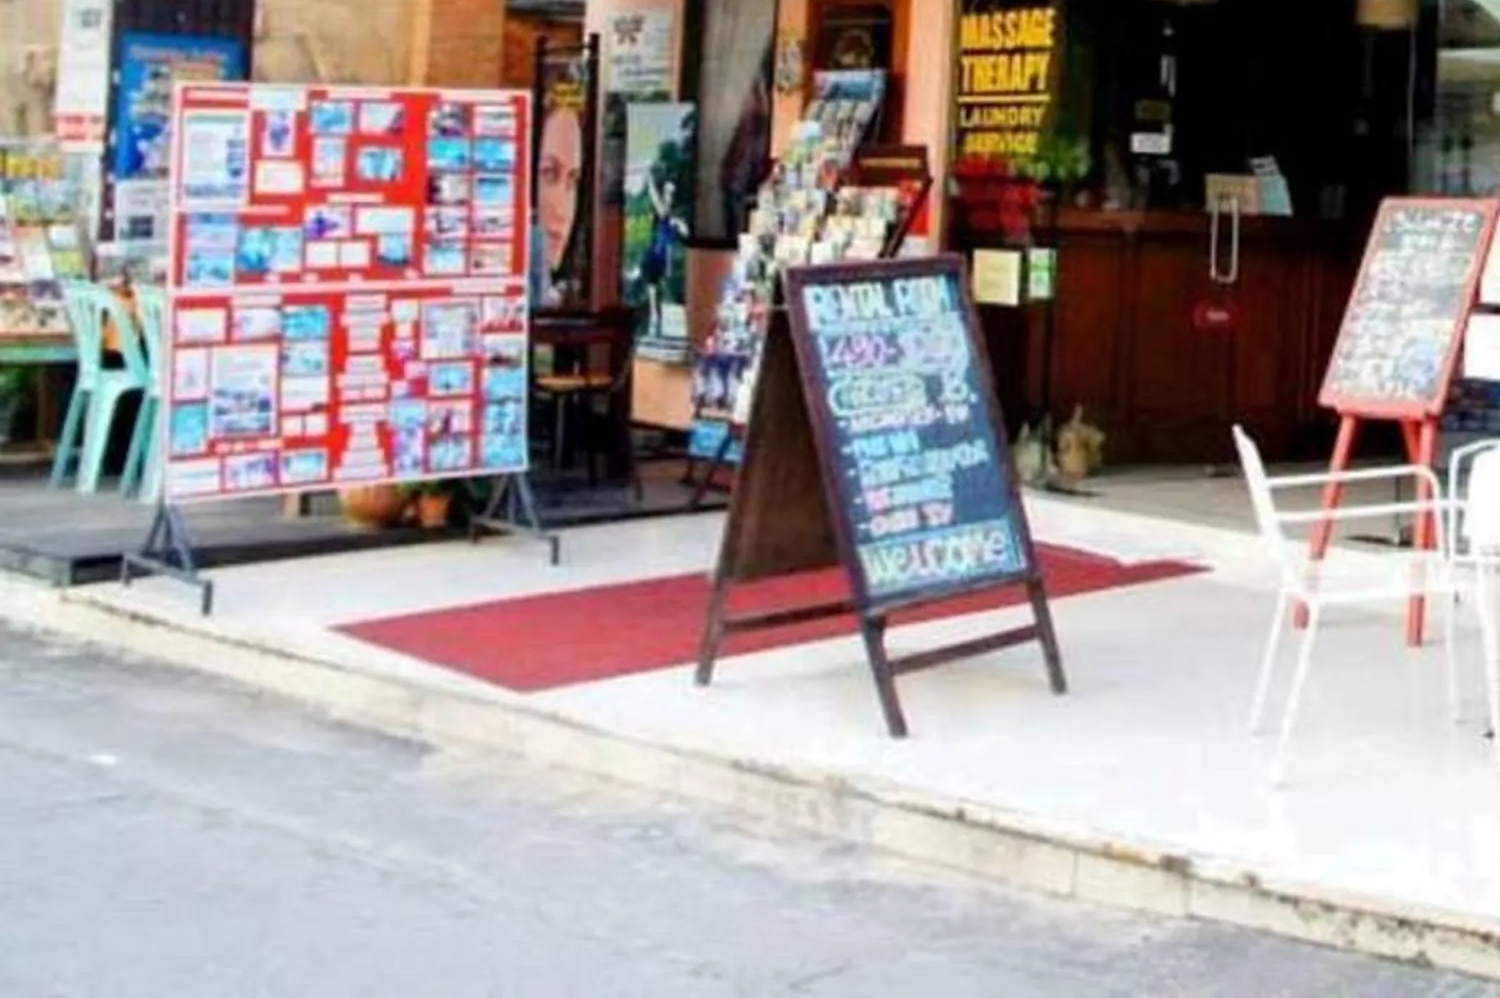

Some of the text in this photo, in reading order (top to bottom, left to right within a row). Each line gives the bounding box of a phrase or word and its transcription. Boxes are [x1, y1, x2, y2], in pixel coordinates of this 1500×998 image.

[960, 7, 1056, 50] MASSAGE
[961, 51, 1051, 93] THERAPY
[959, 104, 1046, 129] LAUNDRY
